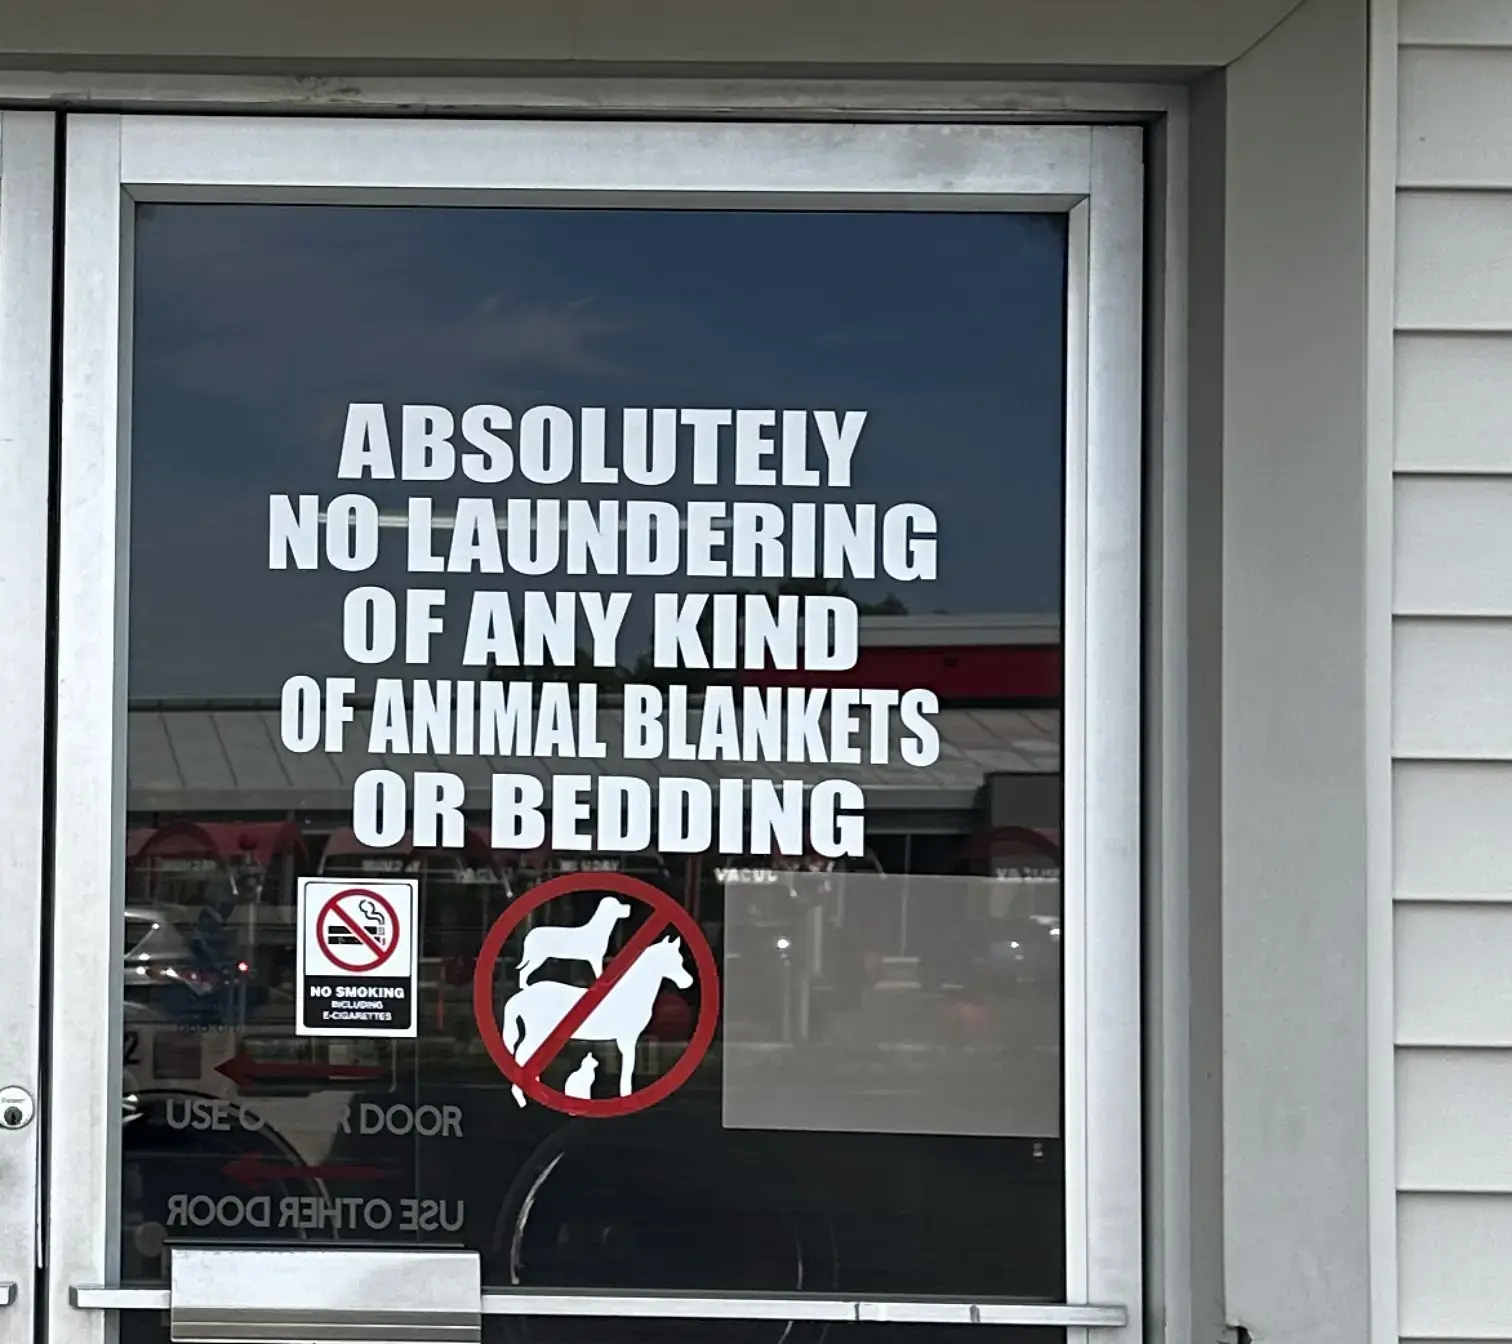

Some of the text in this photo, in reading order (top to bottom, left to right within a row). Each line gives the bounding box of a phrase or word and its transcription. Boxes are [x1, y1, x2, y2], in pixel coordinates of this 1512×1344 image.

[337, 402, 868, 488] ABSOLUTELY
[268, 493, 938, 580] NO LAUNDERING
[342, 586, 859, 671] OF ANY KIND
[281, 674, 941, 768] OF ANIMAL BLANKETS
[352, 769, 866, 858] OR BEDDING
[310, 986, 405, 999] NO SMOKING
[166, 1099, 231, 1131] USE
[360, 1103, 464, 1138] DOOR
